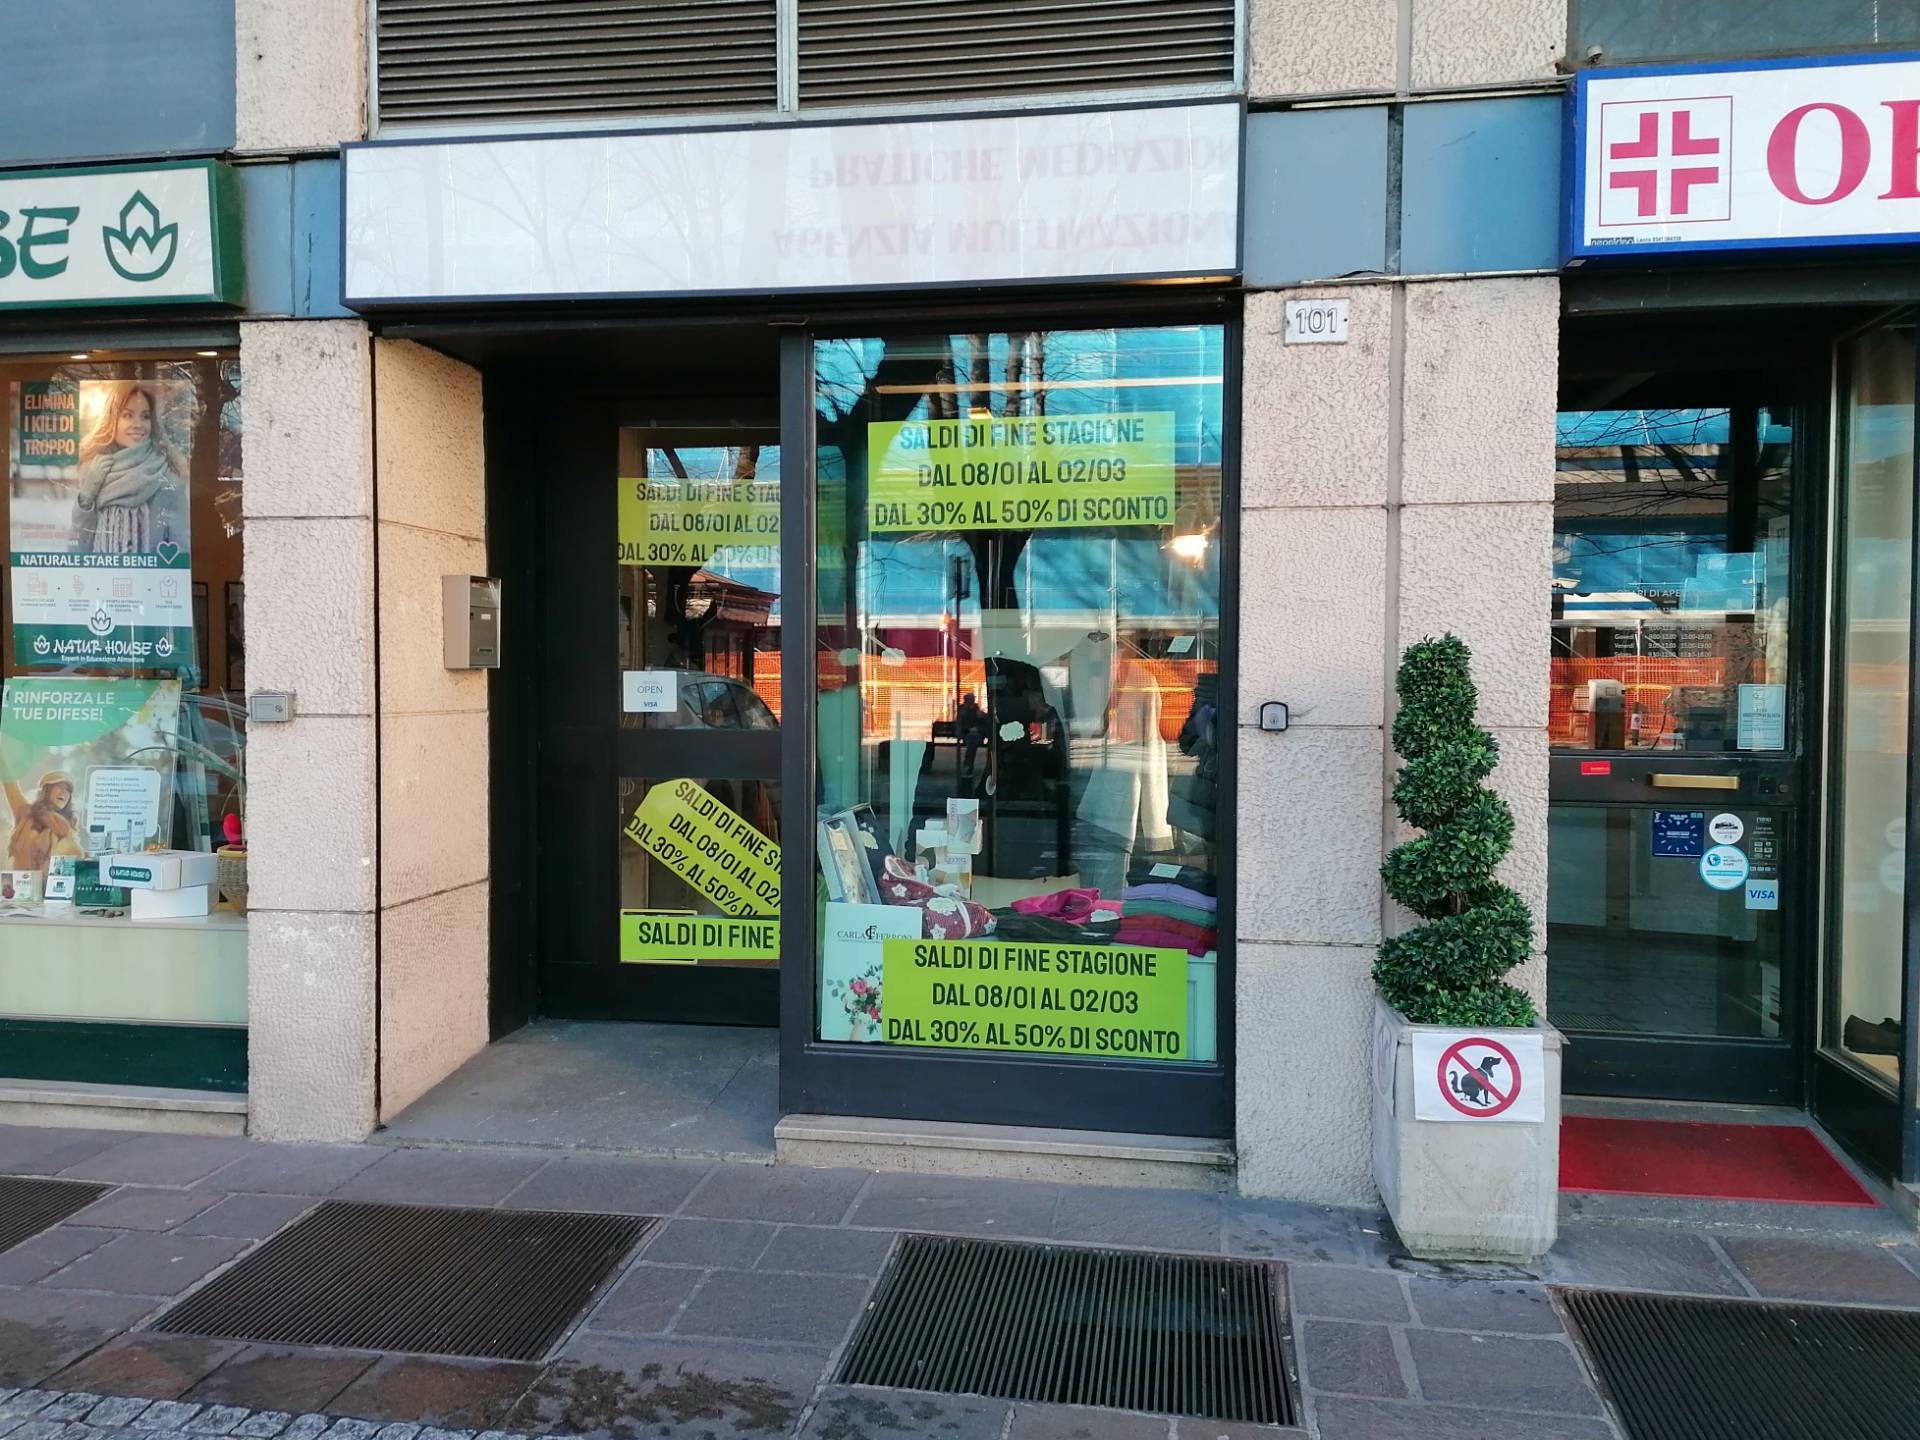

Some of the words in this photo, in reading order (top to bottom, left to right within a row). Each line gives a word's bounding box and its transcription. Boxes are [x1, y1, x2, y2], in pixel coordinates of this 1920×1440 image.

[1296, 308, 1337, 334] 101
[24, 394, 75, 410] ELIMINA
[24, 415, 29, 432] I
[32, 415, 56, 432] KILI
[60, 415, 74, 432] DI
[900, 424, 959, 450] SALDI
[965, 424, 985, 449] DI
[991, 421, 1037, 448] FINE
[1042, 418, 1144, 445] STAGIONE
[24, 439, 75, 456] TROPPO
[918, 462, 957, 488] DAL
[961, 461, 1023, 486] 08/01
[1027, 461, 1053, 484] AL
[1057, 457, 1126, 483] 02/03
[636, 482, 681, 501] SALDI
[686, 483, 702, 502] DI
[706, 483, 742, 503] FINE
[874, 502, 916, 526] DAL
[917, 500, 966, 525] 30%
[972, 500, 998, 524] AL
[1002, 498, 1053, 523] 50%
[1057, 498, 1078, 522] DI
[1083, 495, 1168, 520] SCONTO
[650, 513, 679, 532] DAL
[683, 513, 730, 533] 08/01
[734, 514, 753, 533] AL
[20, 554, 81, 566] NATURALE
[83, 555, 119, 566] STARE
[122, 555, 158, 567] BENE!
[618, 543, 645, 561] DAL
[648, 543, 687, 562] 30%
[691, 544, 709, 562] AL
[713, 544, 755, 563] 50%
[53, 639, 102, 654] NATUR
[105, 640, 153, 656] HOUSE
[14, 691, 94, 705] RINFORZA
[96, 691, 115, 705] LE
[637, 686, 663, 694] OPEN
[13, 707, 43, 720] TUE
[46, 707, 104, 721] DIFESE!
[675, 781, 719, 822] SALDI
[714, 811, 735, 834] DI
[731, 824, 768, 858] FINE
[669, 813, 697, 844] DAL
[697, 834, 742, 875] 08/01
[736, 866, 757, 890] AL
[626, 816, 654, 846] DAL
[652, 836, 689, 872] 30%
[686, 863, 706, 887] AL
[704, 876, 743, 913] 50%
[1750, 890, 1775, 899] VISA
[639, 922, 697, 945] SALDI
[703, 924, 722, 947] DI
[729, 925, 774, 949] FINE
[837, 931, 866, 939] CARLA
[914, 944, 973, 969] SALDI
[979, 946, 999, 970] DI
[1004, 948, 1050, 972] FINE
[1056, 950, 1157, 976] STAGIONE
[932, 983, 970, 1007] DAL
[974, 983, 1036, 1010] 08/01
[1040, 987, 1065, 1011] AL
[1071, 987, 1138, 1014] 02/03
[888, 1018, 926, 1042] DAL
[930, 1019, 979, 1045] 30%
[985, 1021, 1010, 1046] AL
[1014, 1022, 1066, 1048] 50%
[1070, 1026, 1090, 1050] DI
[1095, 1028, 1180, 1054] SCONTO
